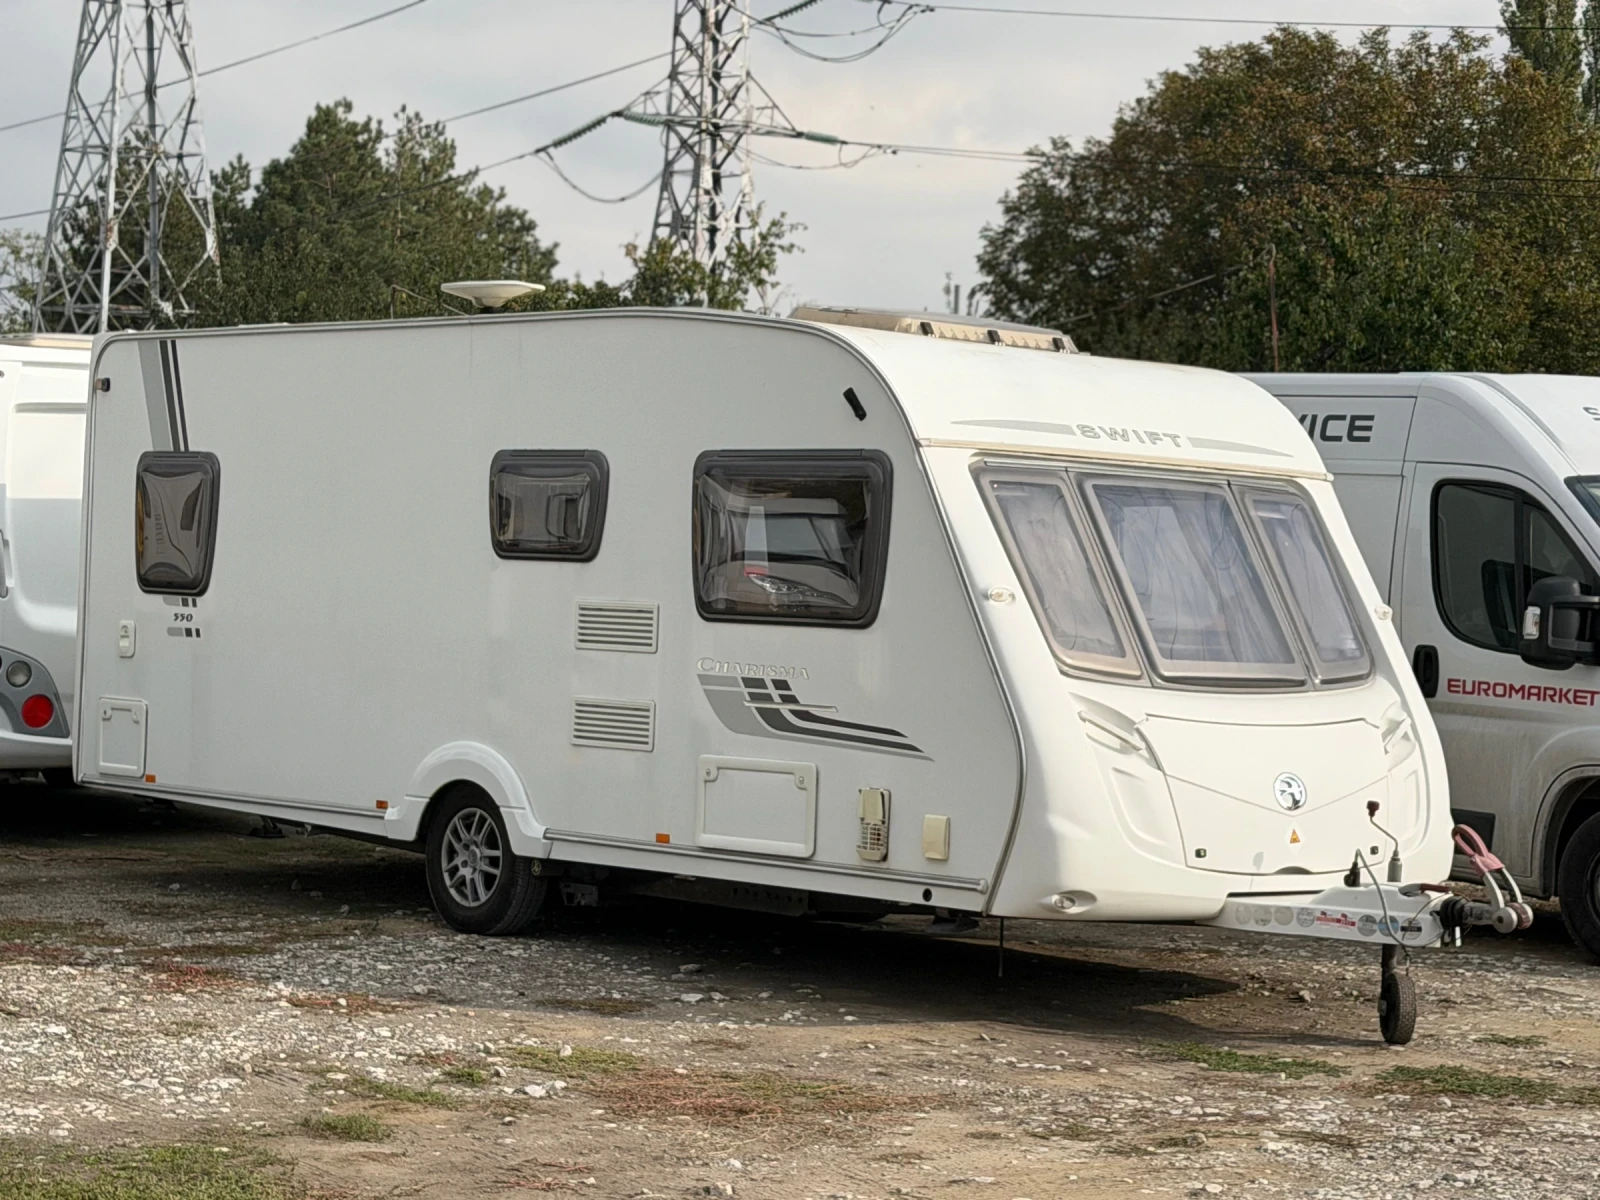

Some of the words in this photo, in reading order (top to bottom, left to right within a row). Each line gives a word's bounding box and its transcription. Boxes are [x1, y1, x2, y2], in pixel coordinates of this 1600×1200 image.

[1076, 423, 1181, 448] SWIFT
[1298, 413, 1375, 442] ICE
[173, 612, 193, 622] 550
[696, 657, 809, 680] CHARISMA
[1447, 678, 1600, 706] EUROMARKET
